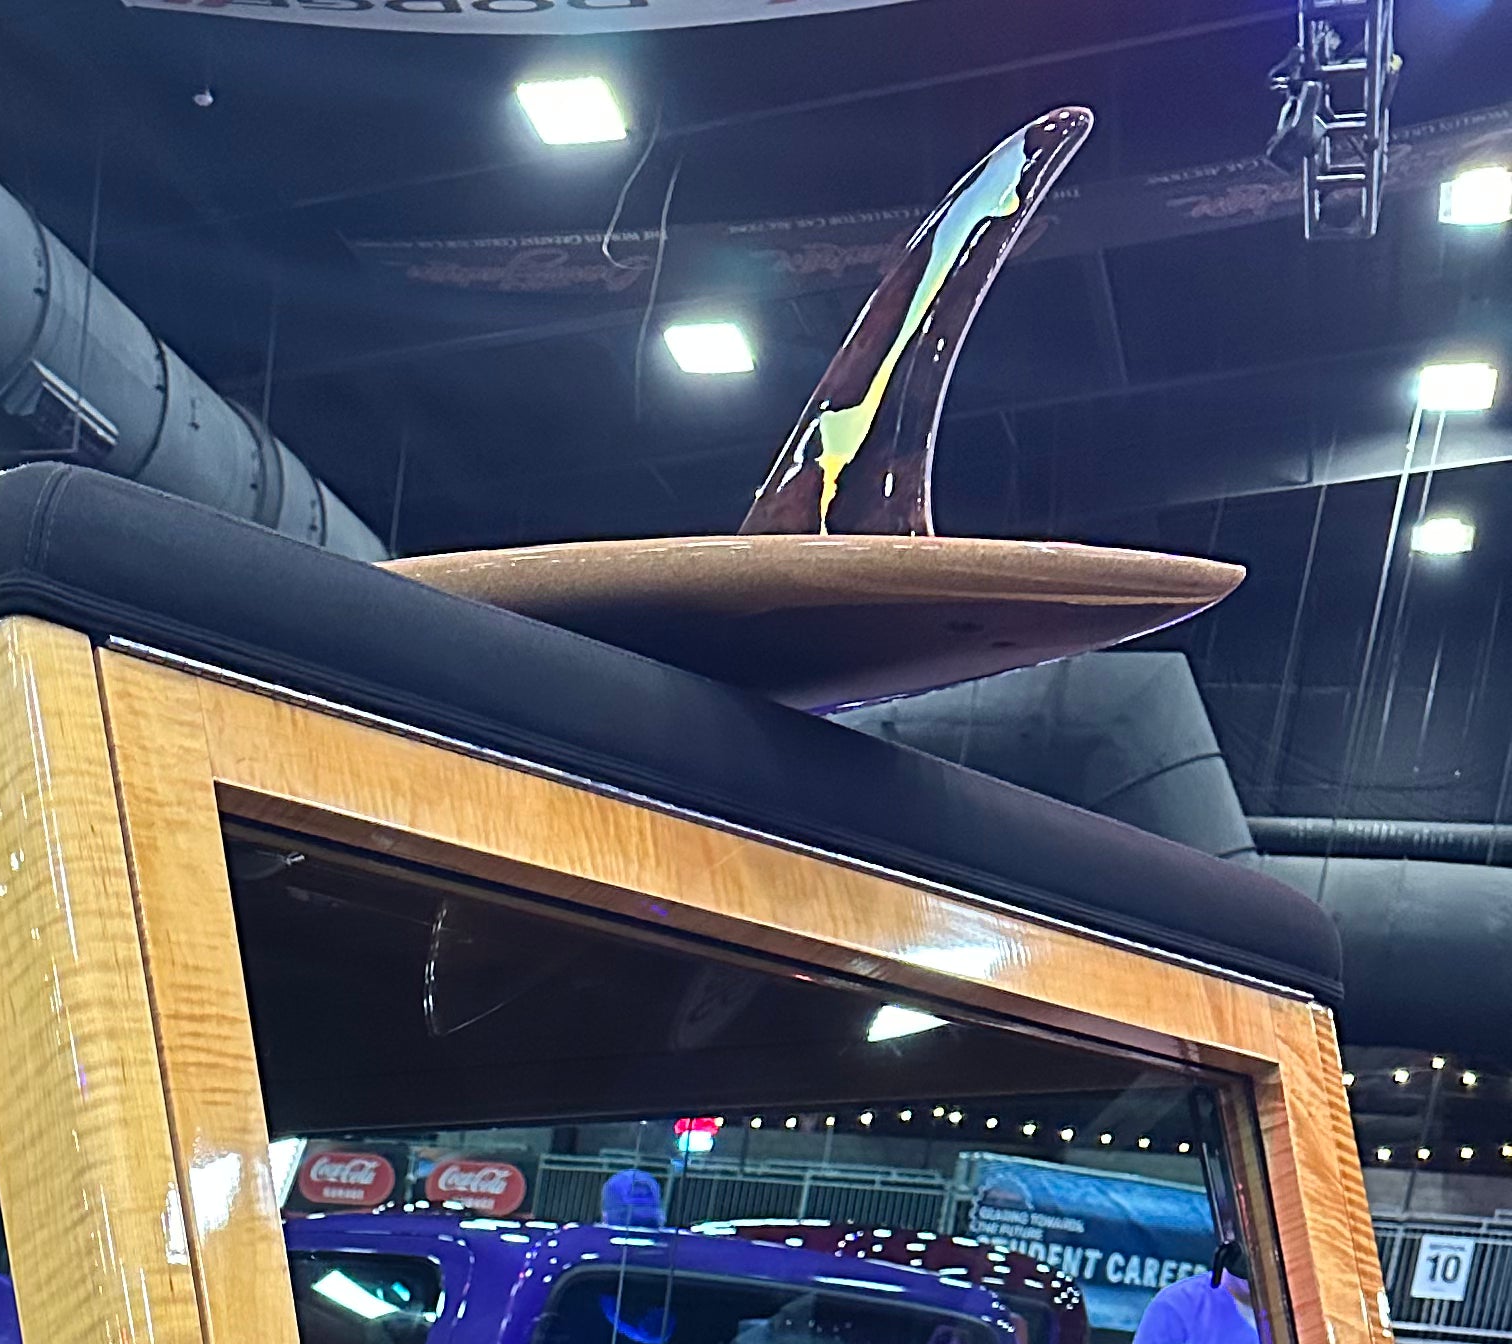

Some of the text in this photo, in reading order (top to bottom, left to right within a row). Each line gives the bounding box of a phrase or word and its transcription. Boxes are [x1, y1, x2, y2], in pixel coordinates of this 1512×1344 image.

[309, 1156, 380, 1185] Coca-Cola
[438, 1165, 513, 1195] Coca-Cola
[1426, 1253, 1461, 1284] 10
